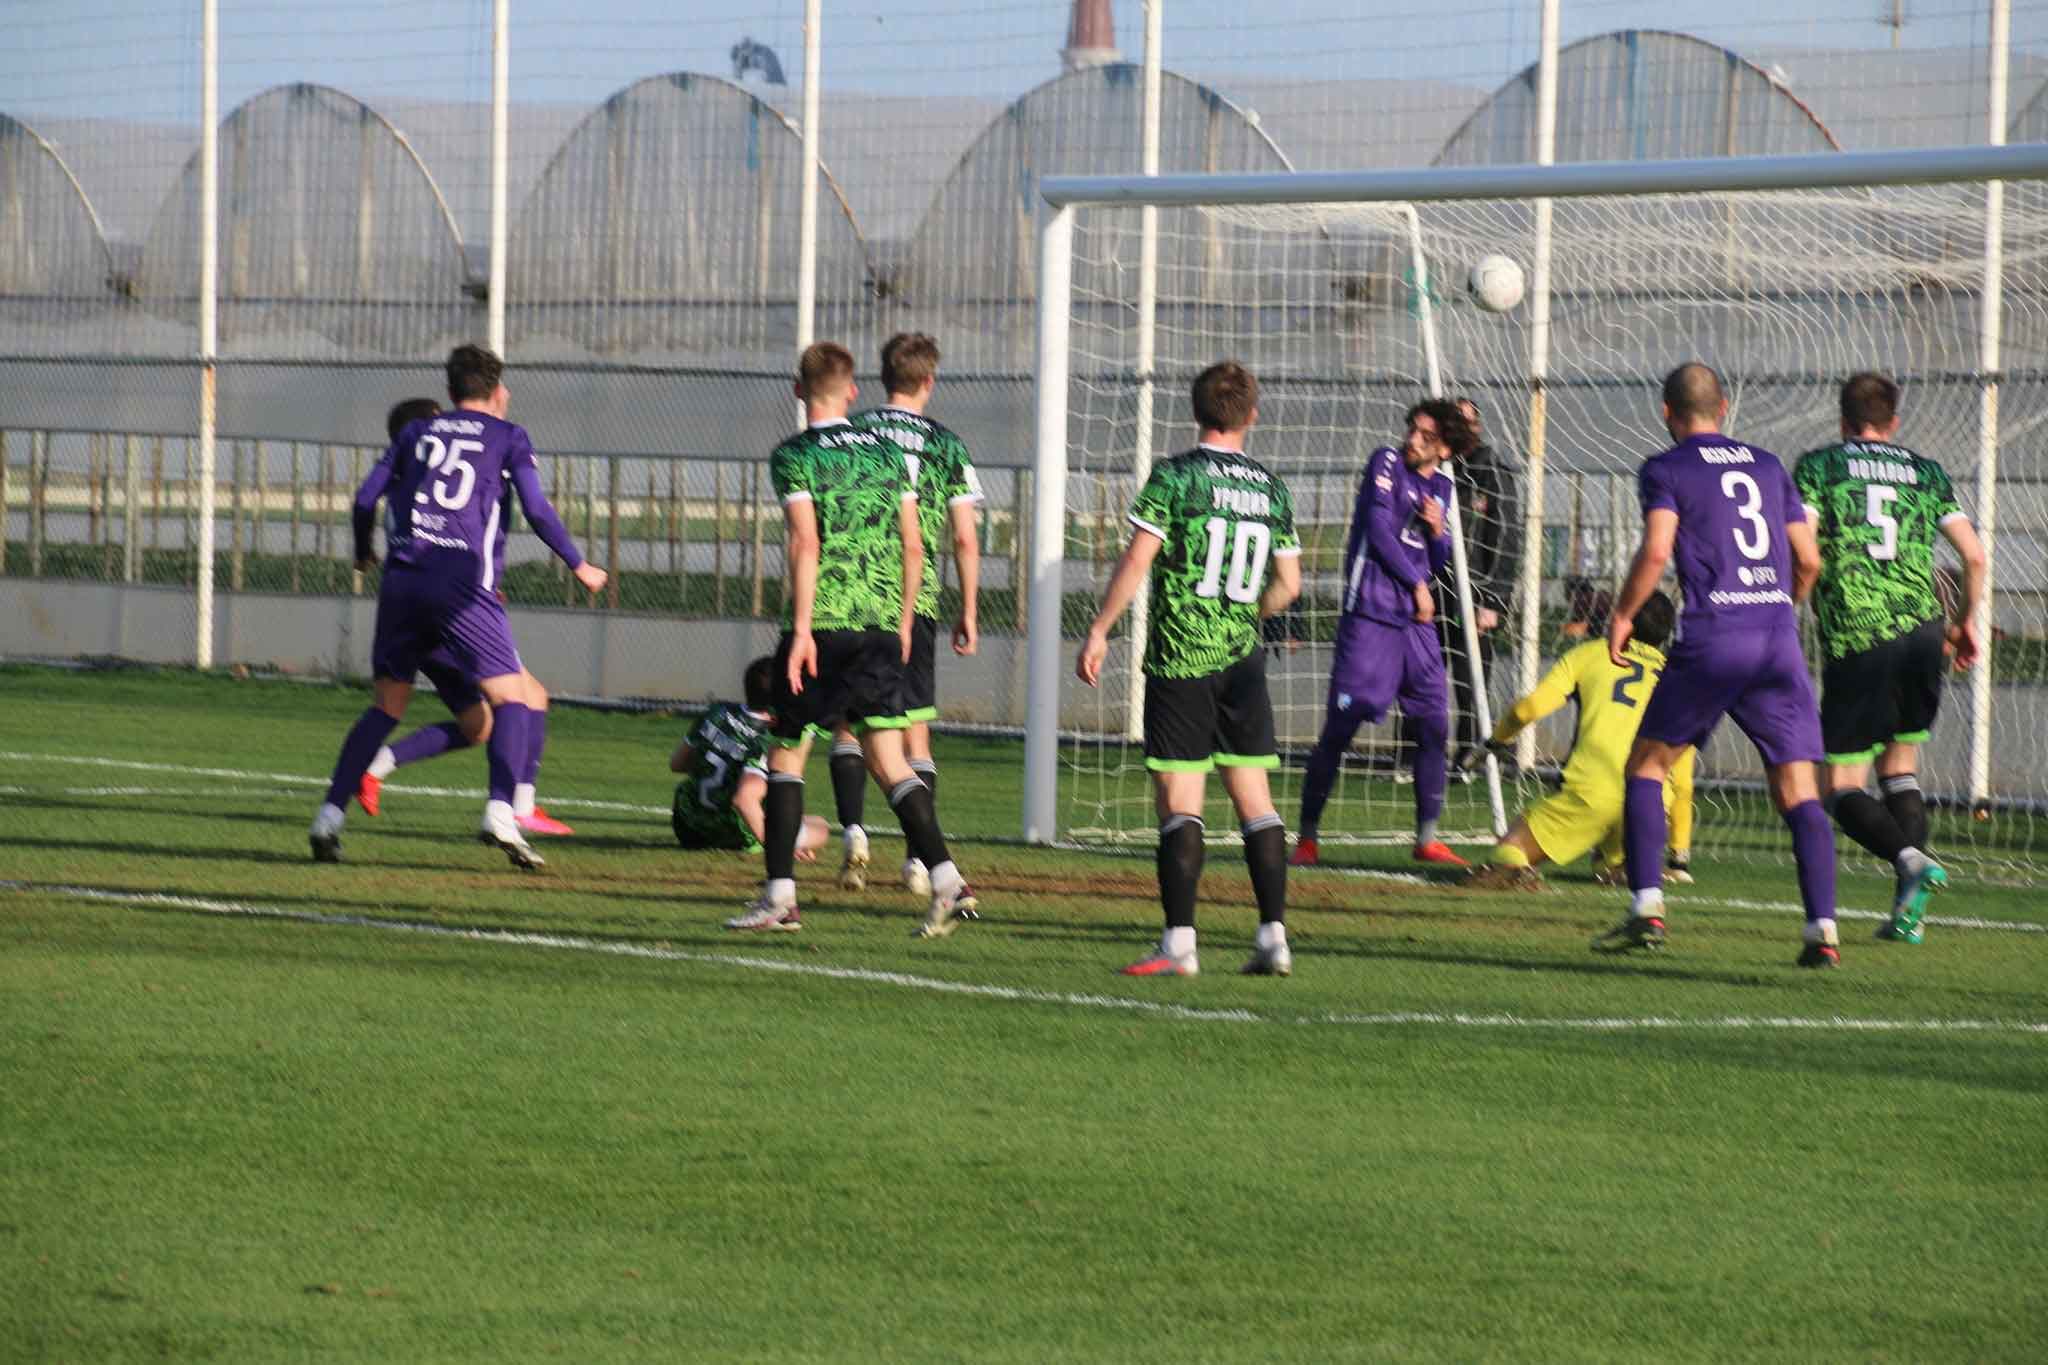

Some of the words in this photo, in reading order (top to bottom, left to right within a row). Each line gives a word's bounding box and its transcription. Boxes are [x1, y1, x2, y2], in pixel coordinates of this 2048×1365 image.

[414, 433, 485, 511] 25
[1720, 470, 1770, 560] 3
[1866, 484, 1898, 561] 5
[1195, 516, 1271, 603] 10
